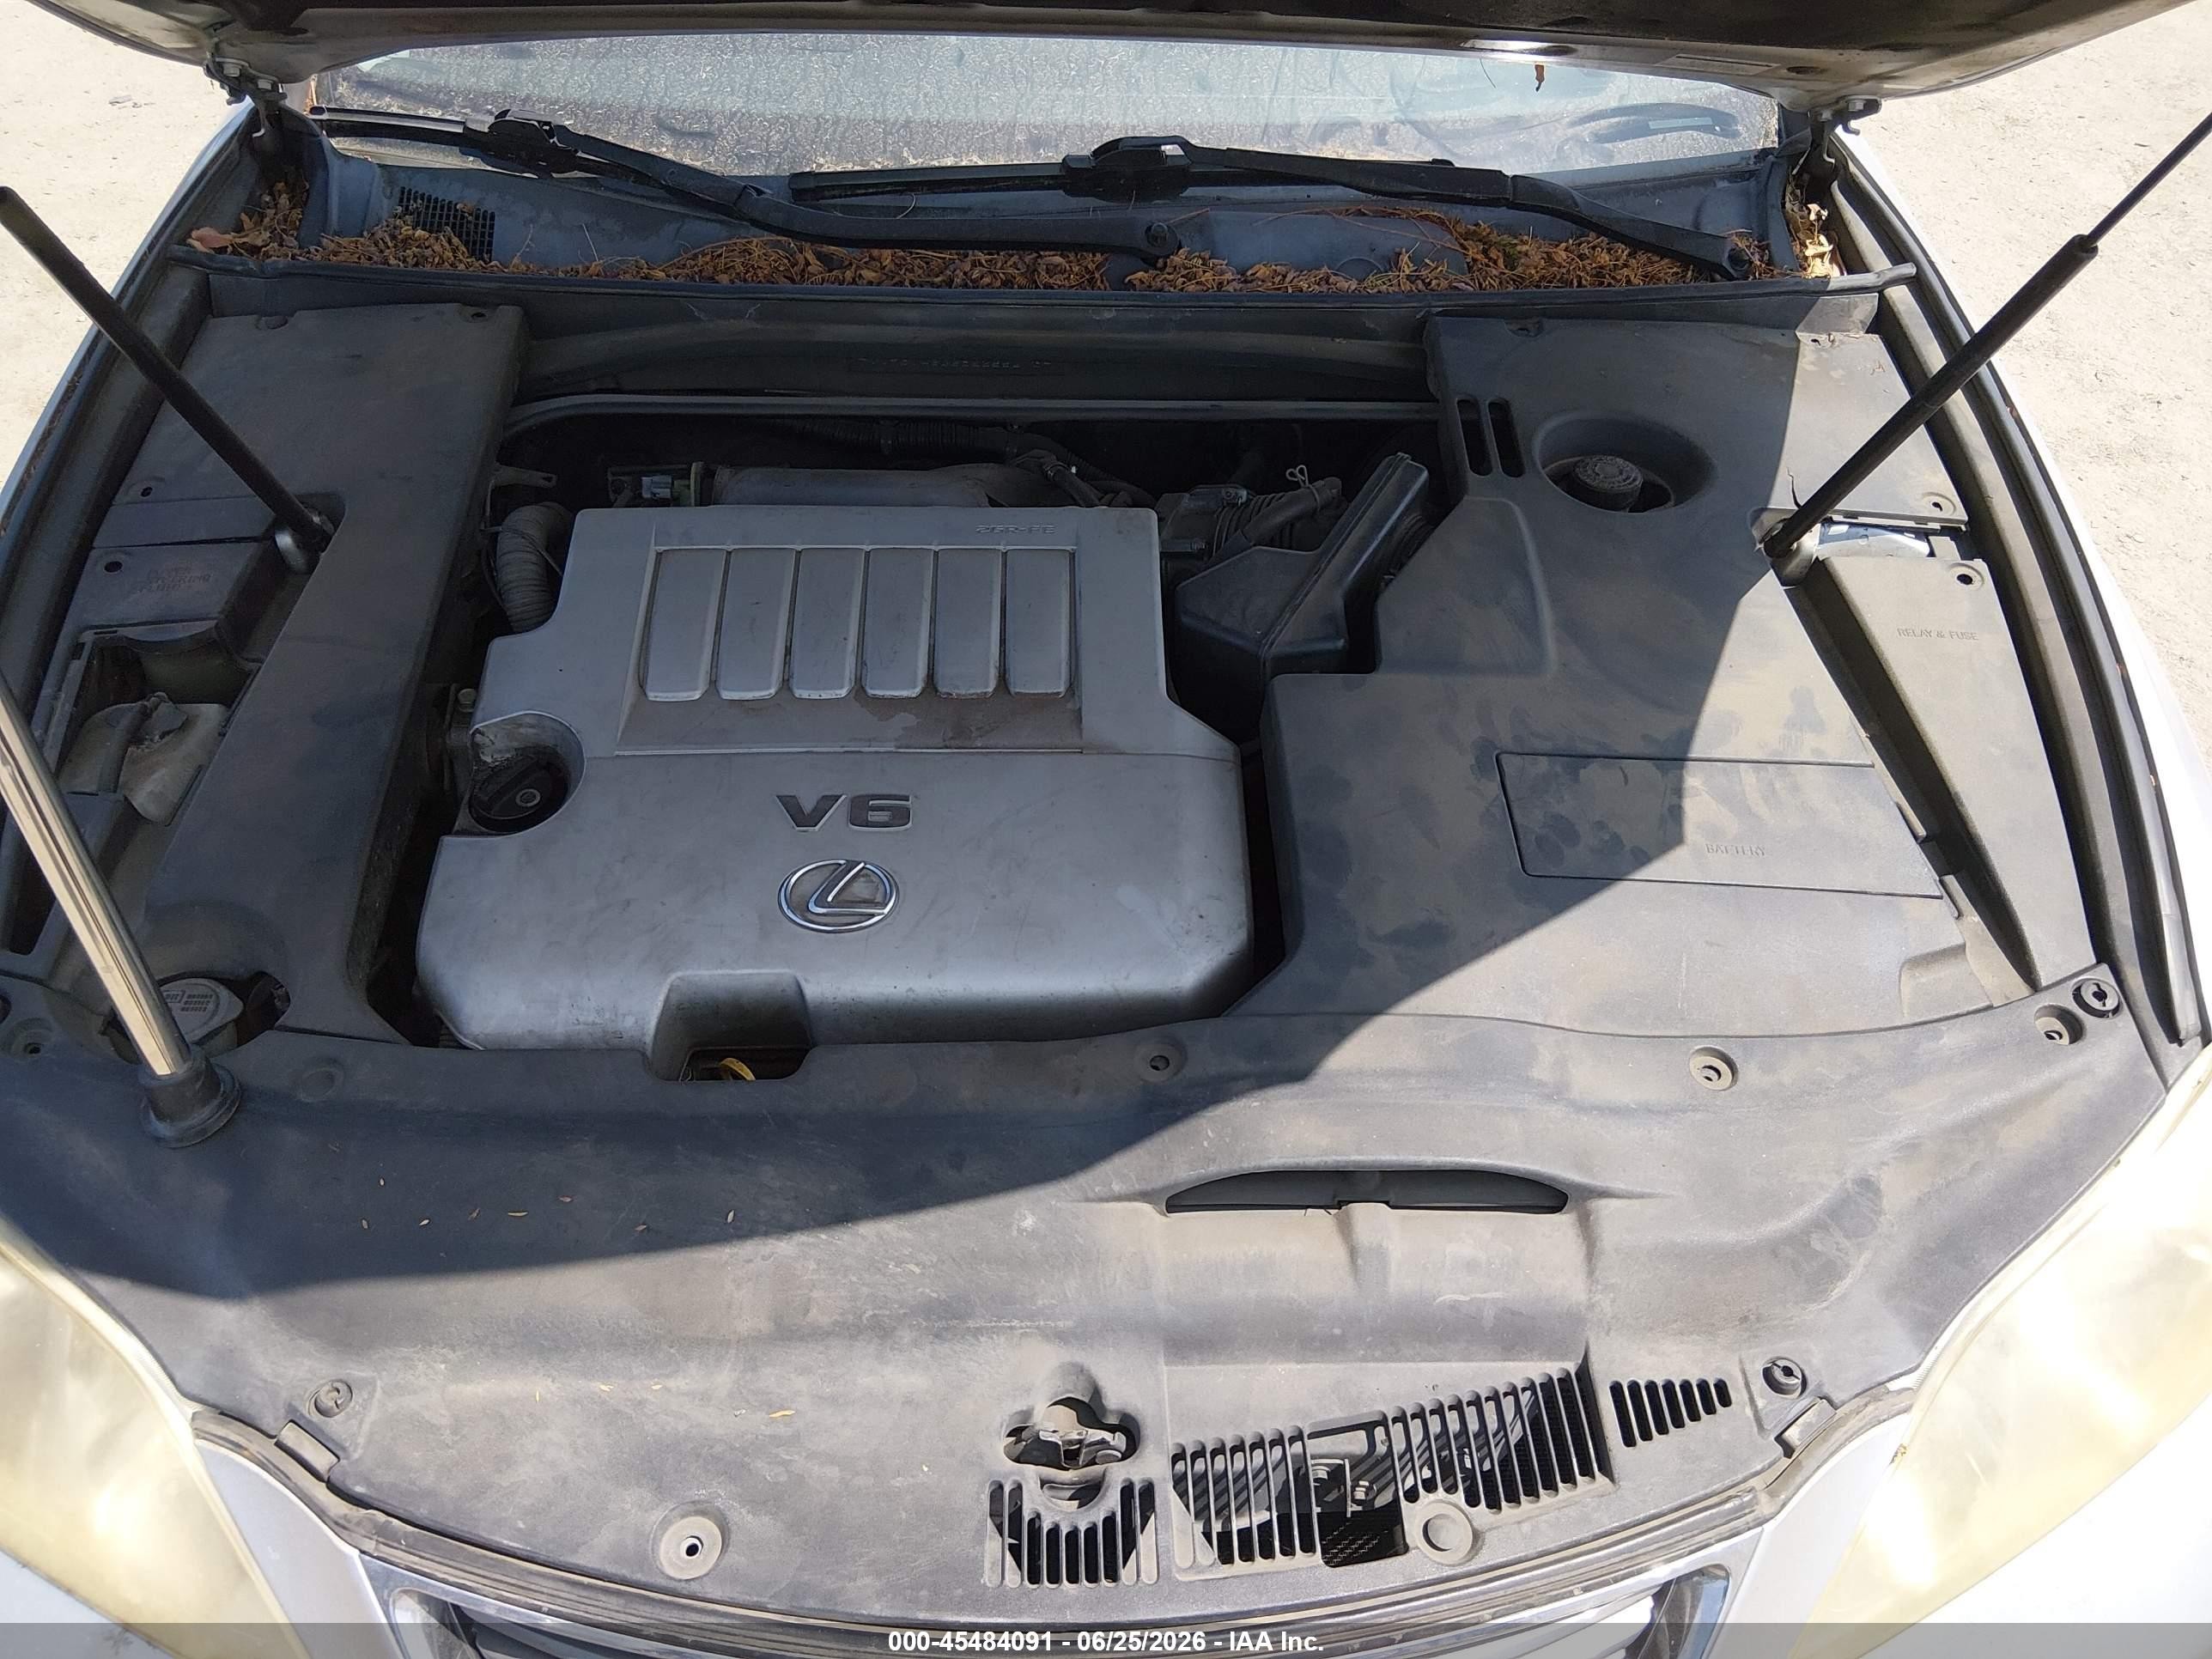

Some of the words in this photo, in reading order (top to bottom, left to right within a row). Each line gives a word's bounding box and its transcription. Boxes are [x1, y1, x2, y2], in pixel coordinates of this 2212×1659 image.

[1896, 627, 1932, 638] RELAY
[1936, 629, 1946, 638] &
[1948, 629, 1978, 641] FUSE
[774, 794, 914, 832] V6
[1705, 842, 1765, 857] BATTERY
